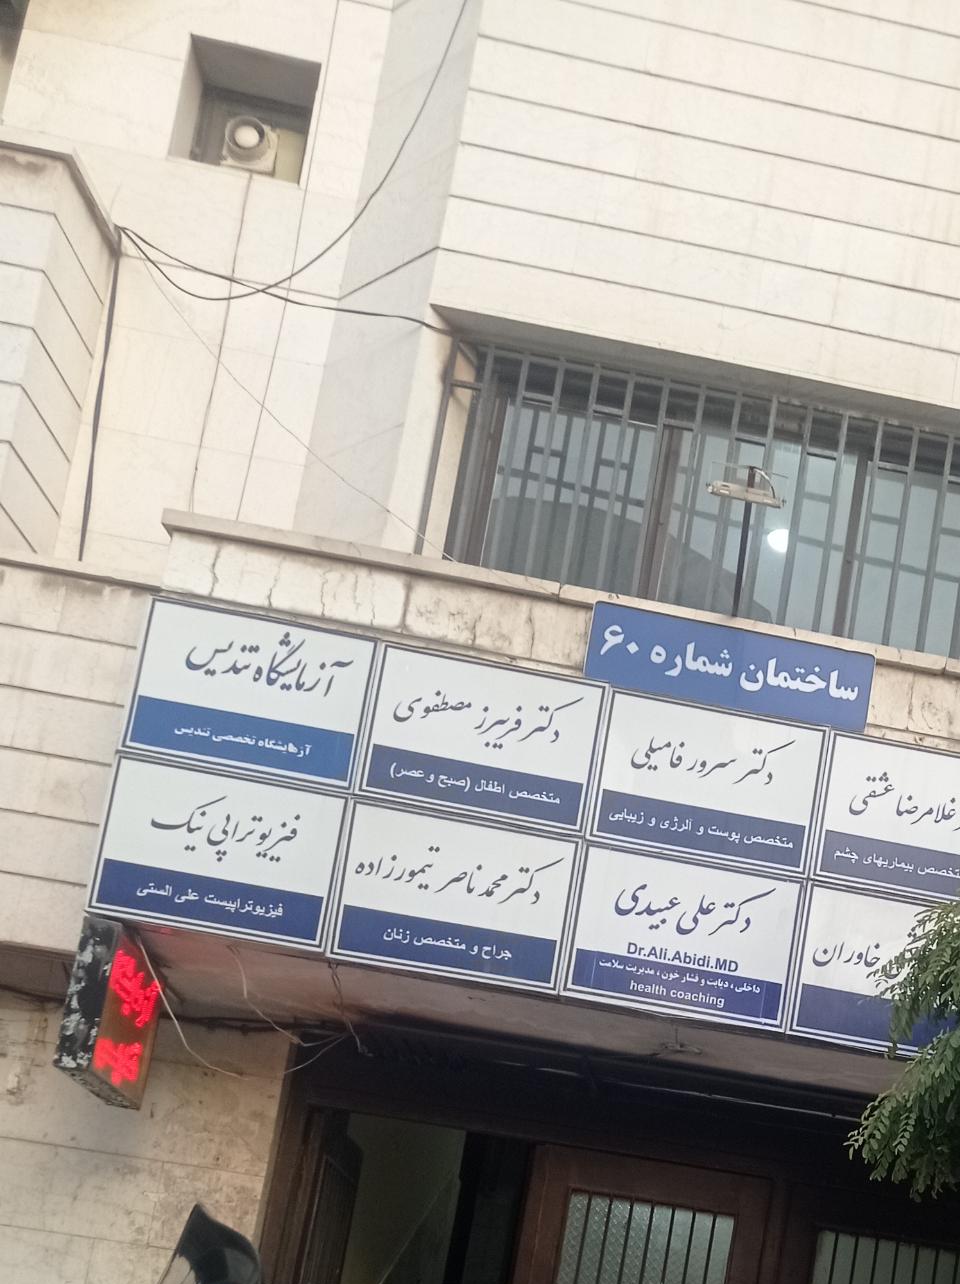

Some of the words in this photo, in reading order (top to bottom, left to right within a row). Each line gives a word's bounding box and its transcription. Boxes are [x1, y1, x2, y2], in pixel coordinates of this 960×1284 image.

[599, 624, 640, 656] ۶۰
[185, 640, 260, 677] تندیس
[252, 631, 354, 697] آزمایشگاه
[649, 641, 733, 678] شماره
[739, 656, 860, 702] ساختمان
[392, 689, 473, 723] مصطفوی
[473, 705, 523, 750] فریبرز
[517, 696, 585, 744] دکتر
[174, 724, 211, 738] تندیس
[211, 733, 256, 746] تخصصی
[257, 737, 313, 758] آزمایشگاه
[630, 735, 685, 772] فامیلی
[389, 762, 425, 779] عصر)
[686, 757, 738, 779] سرور
[732, 739, 797, 786] دکتر
[426, 773, 435, 783] و
[437, 772, 471, 792] (صبح
[474, 778, 505, 794] اطفال
[508, 790, 561, 805] متخصص
[848, 771, 895, 816] عشقی
[608, 807, 645, 825] زیبایی
[895, 794, 957, 826] غلامرضا
[150, 795, 228, 852] نیک
[648, 816, 656, 827] و
[696, 825, 705, 836] و
[206, 813, 301, 863] فیزیوتراپی
[707, 825, 741, 844] پوست
[743, 834, 794, 849] متخصص
[833, 846, 859, 864] چشم
[862, 852, 914, 873] بیماریهای
[136, 882, 173, 897] الستی
[433, 864, 483, 894] ناصر
[477, 873, 508, 897] محمد
[496, 857, 565, 905] دکتر
[173, 888, 200, 904] علی
[203, 894, 284, 917] فیزیوتراپیست
[614, 883, 681, 930] عبیدی
[675, 894, 716, 936] علی
[708, 887, 777, 936] دکتر
[383, 927, 410, 944] زنان
[413, 936, 467, 951] متخصص
[469, 945, 479, 956] و
[481, 944, 513, 961] جراح
[626, 941, 739, 973] Dr.Ali.Abidi.MD
[812, 941, 881, 968] خاوران
[598, 958, 624, 970] سلامت
[625, 964, 655, 976] مدیریت
[682, 972, 700, 984] فشار
[706, 978, 729, 989] دیابت
[629, 979, 667, 997] health
[670, 987, 726, 1008] coaching
